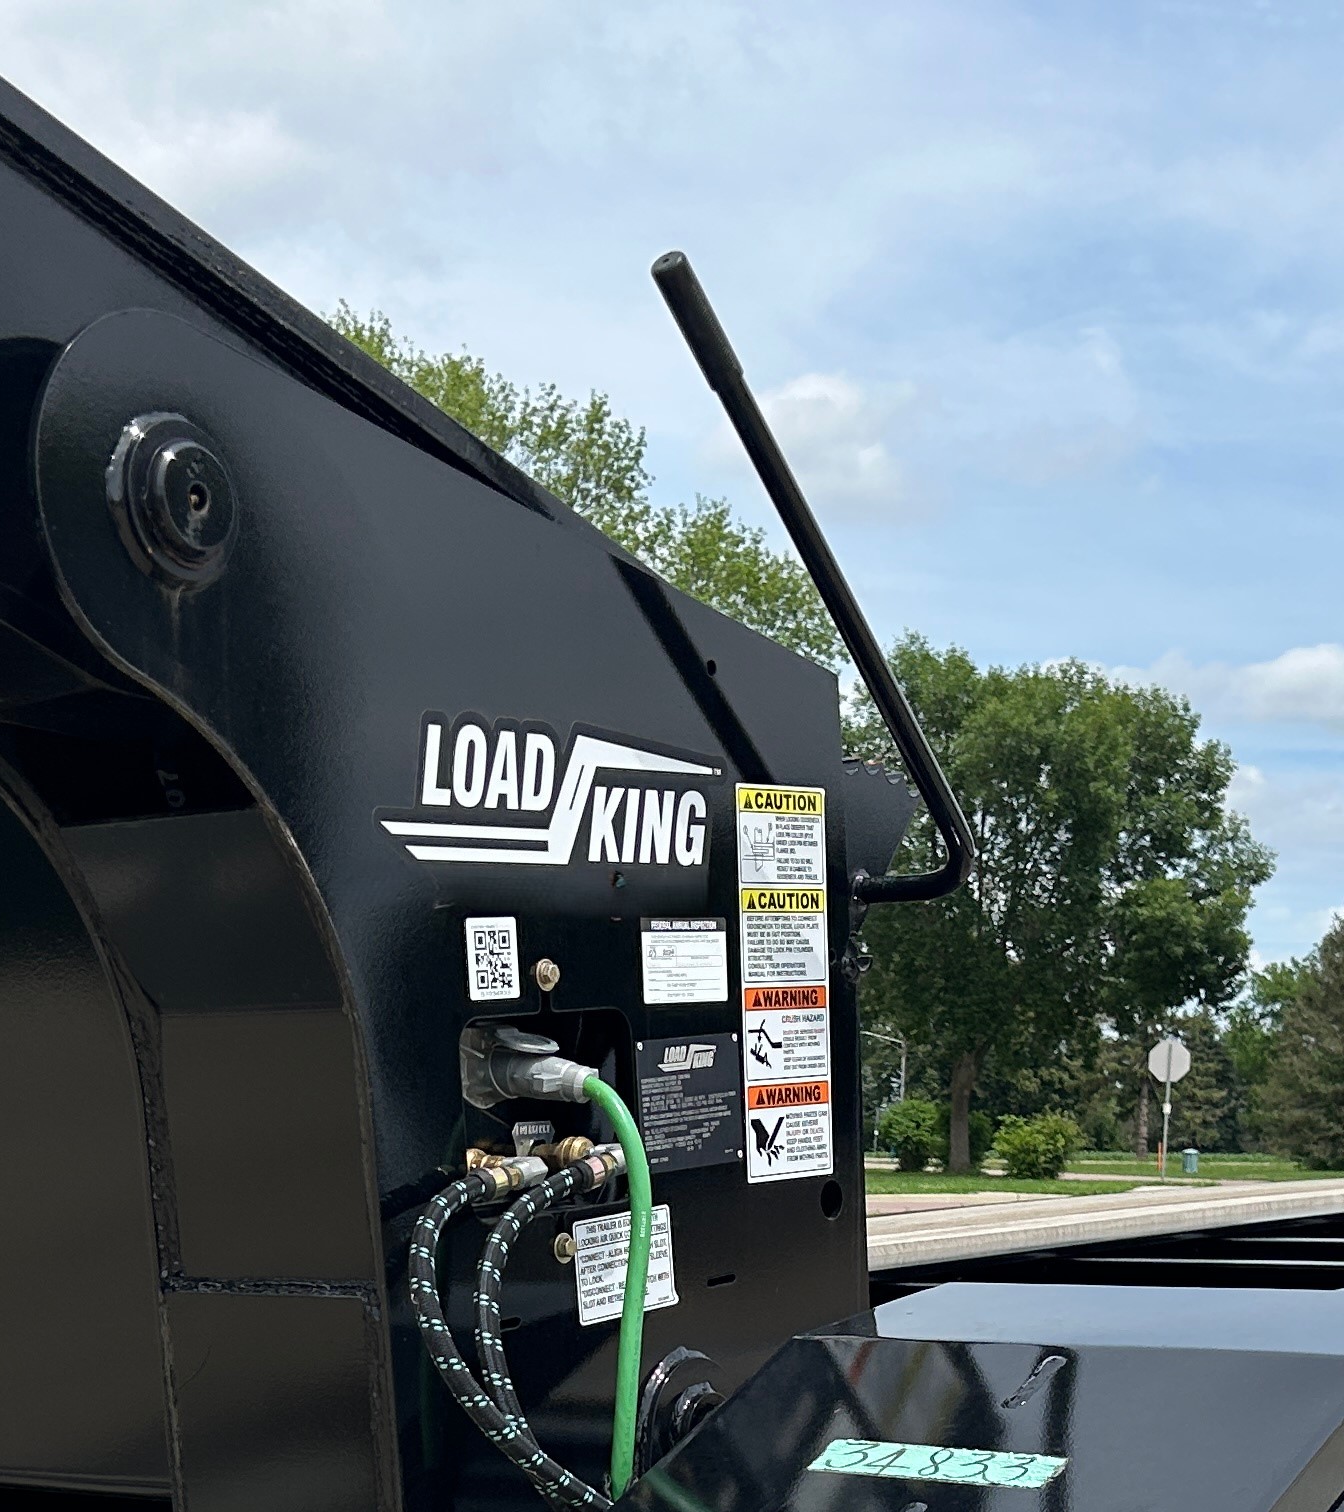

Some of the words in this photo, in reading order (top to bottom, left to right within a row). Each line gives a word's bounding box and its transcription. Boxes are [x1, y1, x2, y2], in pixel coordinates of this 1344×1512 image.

[422, 724, 555, 811] LOAD
[755, 792, 816, 811] CAUTION
[588, 786, 706, 866] KING
[758, 893, 819, 909] CAUTION
[763, 989, 818, 1007] WARNING
[664, 1045, 687, 1063] LOAD
[692, 1051, 714, 1069] KING
[766, 1085, 821, 1105] WARNING
[825, 1441, 1037, 1482] 34833
